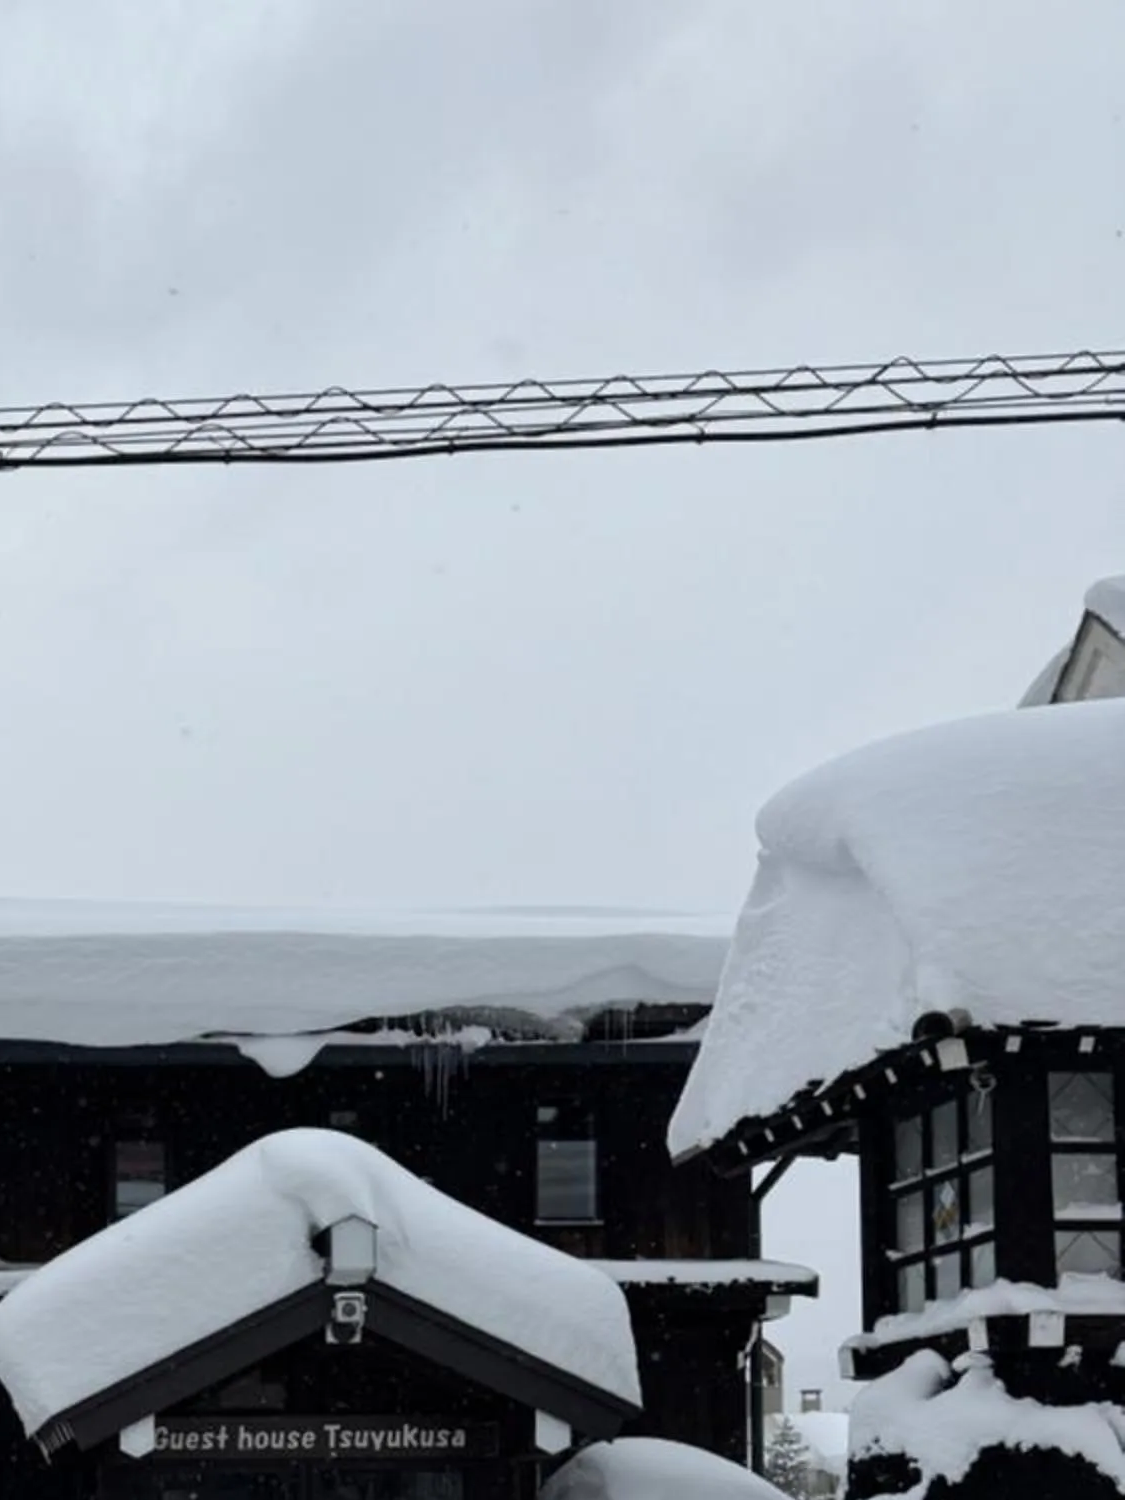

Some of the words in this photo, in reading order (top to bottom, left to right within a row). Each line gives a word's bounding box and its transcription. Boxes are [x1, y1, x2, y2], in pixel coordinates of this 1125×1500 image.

[155, 1425, 228, 1449] Guest
[238, 1425, 315, 1449] house
[323, 1423, 466, 1451] Tsuyukusa
